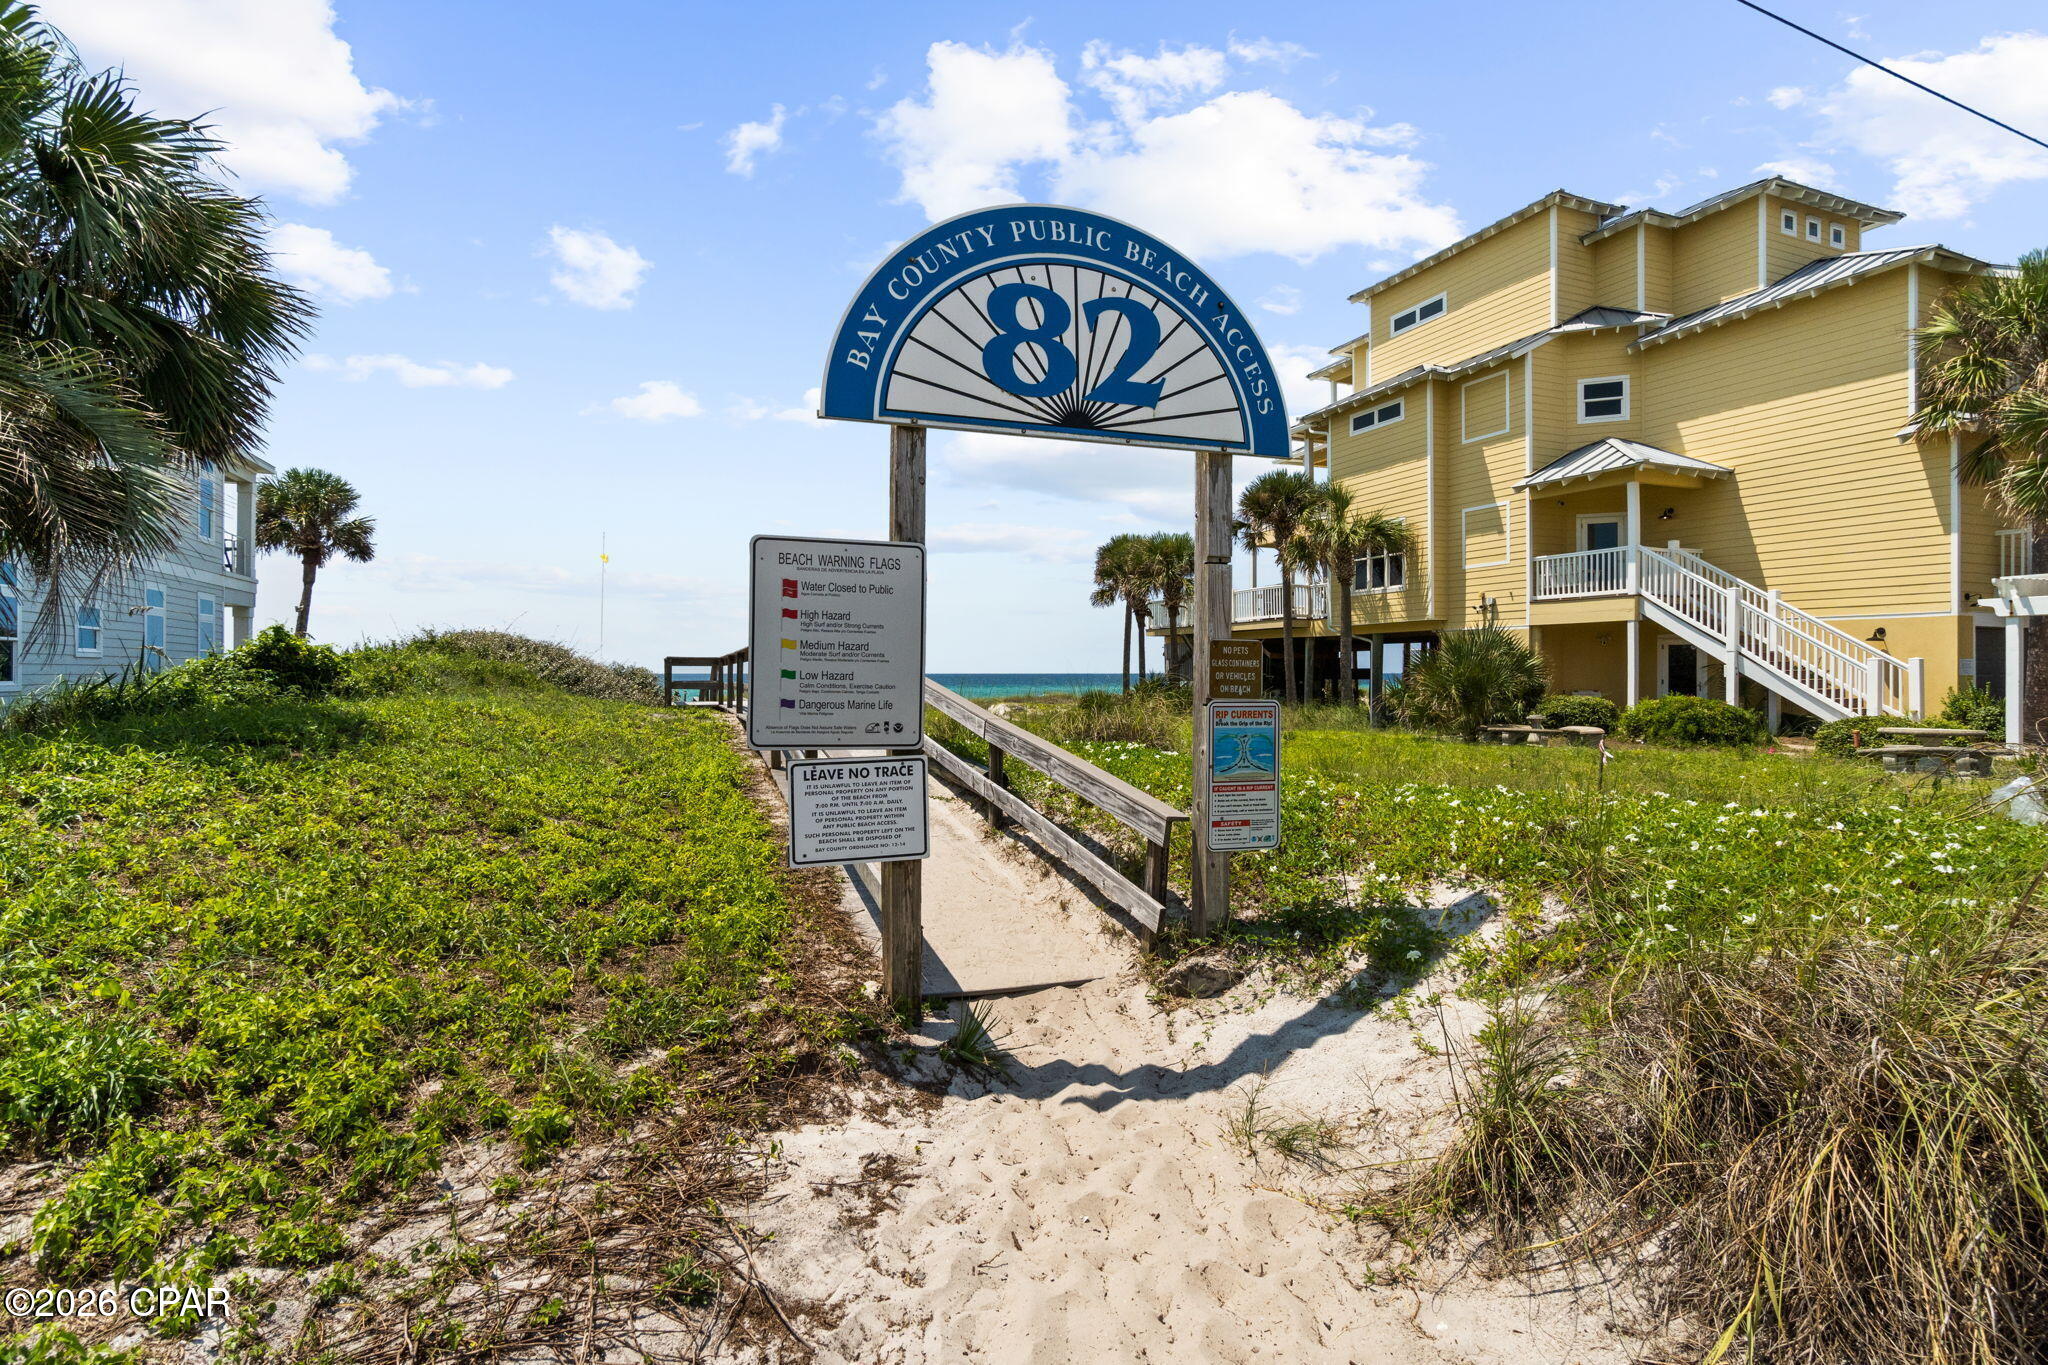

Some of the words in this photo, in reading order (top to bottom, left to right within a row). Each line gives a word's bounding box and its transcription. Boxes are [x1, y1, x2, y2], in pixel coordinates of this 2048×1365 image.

[847, 303, 888, 371] BAY
[887, 224, 999, 300] COUNTY
[1010, 220, 1112, 252] PUBLIC
[1125, 240, 1210, 306] BEACH
[1212, 313, 1274, 416] ACCESS
[982, 282, 1166, 409] 82
[778, 553, 812, 566] BEACH
[818, 554, 864, 568] WARNING
[870, 557, 901, 570] FLAGS
[801, 581, 825, 592] Water
[828, 582, 856, 593] Closed
[859, 585, 866, 593] to
[869, 584, 894, 594] Public
[800, 610, 819, 621] High
[822, 610, 850, 620] Hazard
[800, 640, 835, 650] Medium
[838, 641, 869, 651] Hazard
[800, 670, 818, 680] Low
[822, 671, 854, 680] Hazard
[1216, 672, 1223, 680] OR
[1226, 672, 1256, 680] VEHICLES
[799, 699, 845, 711] Dangerous
[847, 700, 875, 709] Marine
[878, 700, 893, 709] Life
[804, 769, 844, 781] LEAVE
[849, 767, 870, 779] NO
[874, 765, 914, 778] TRACE
